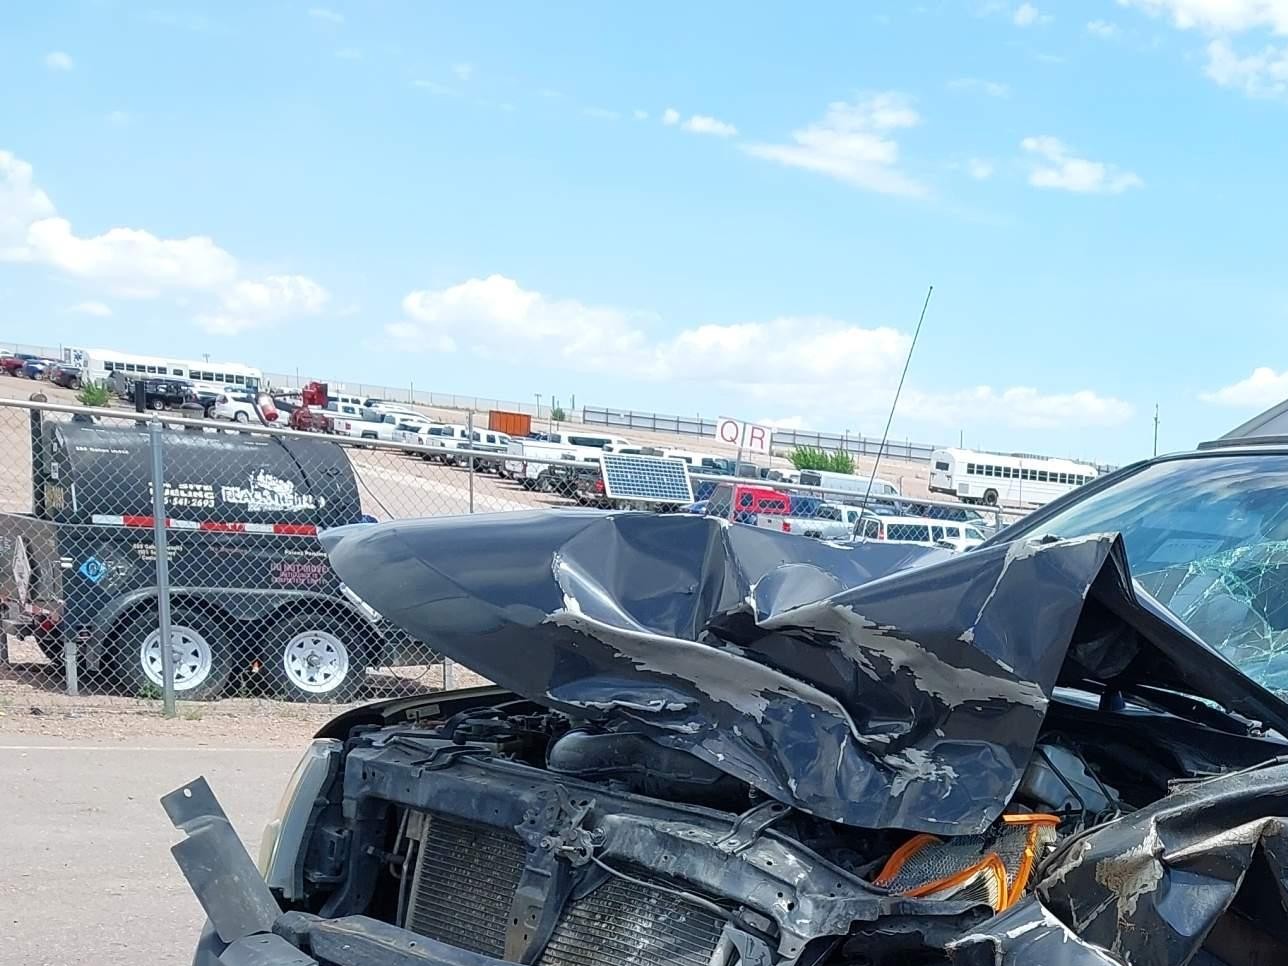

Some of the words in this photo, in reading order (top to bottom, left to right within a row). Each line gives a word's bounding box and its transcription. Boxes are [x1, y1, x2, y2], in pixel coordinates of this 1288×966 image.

[720, 420, 739, 445] Q
[749, 426, 766, 450] R
[178, 483, 214, 491] SITE
